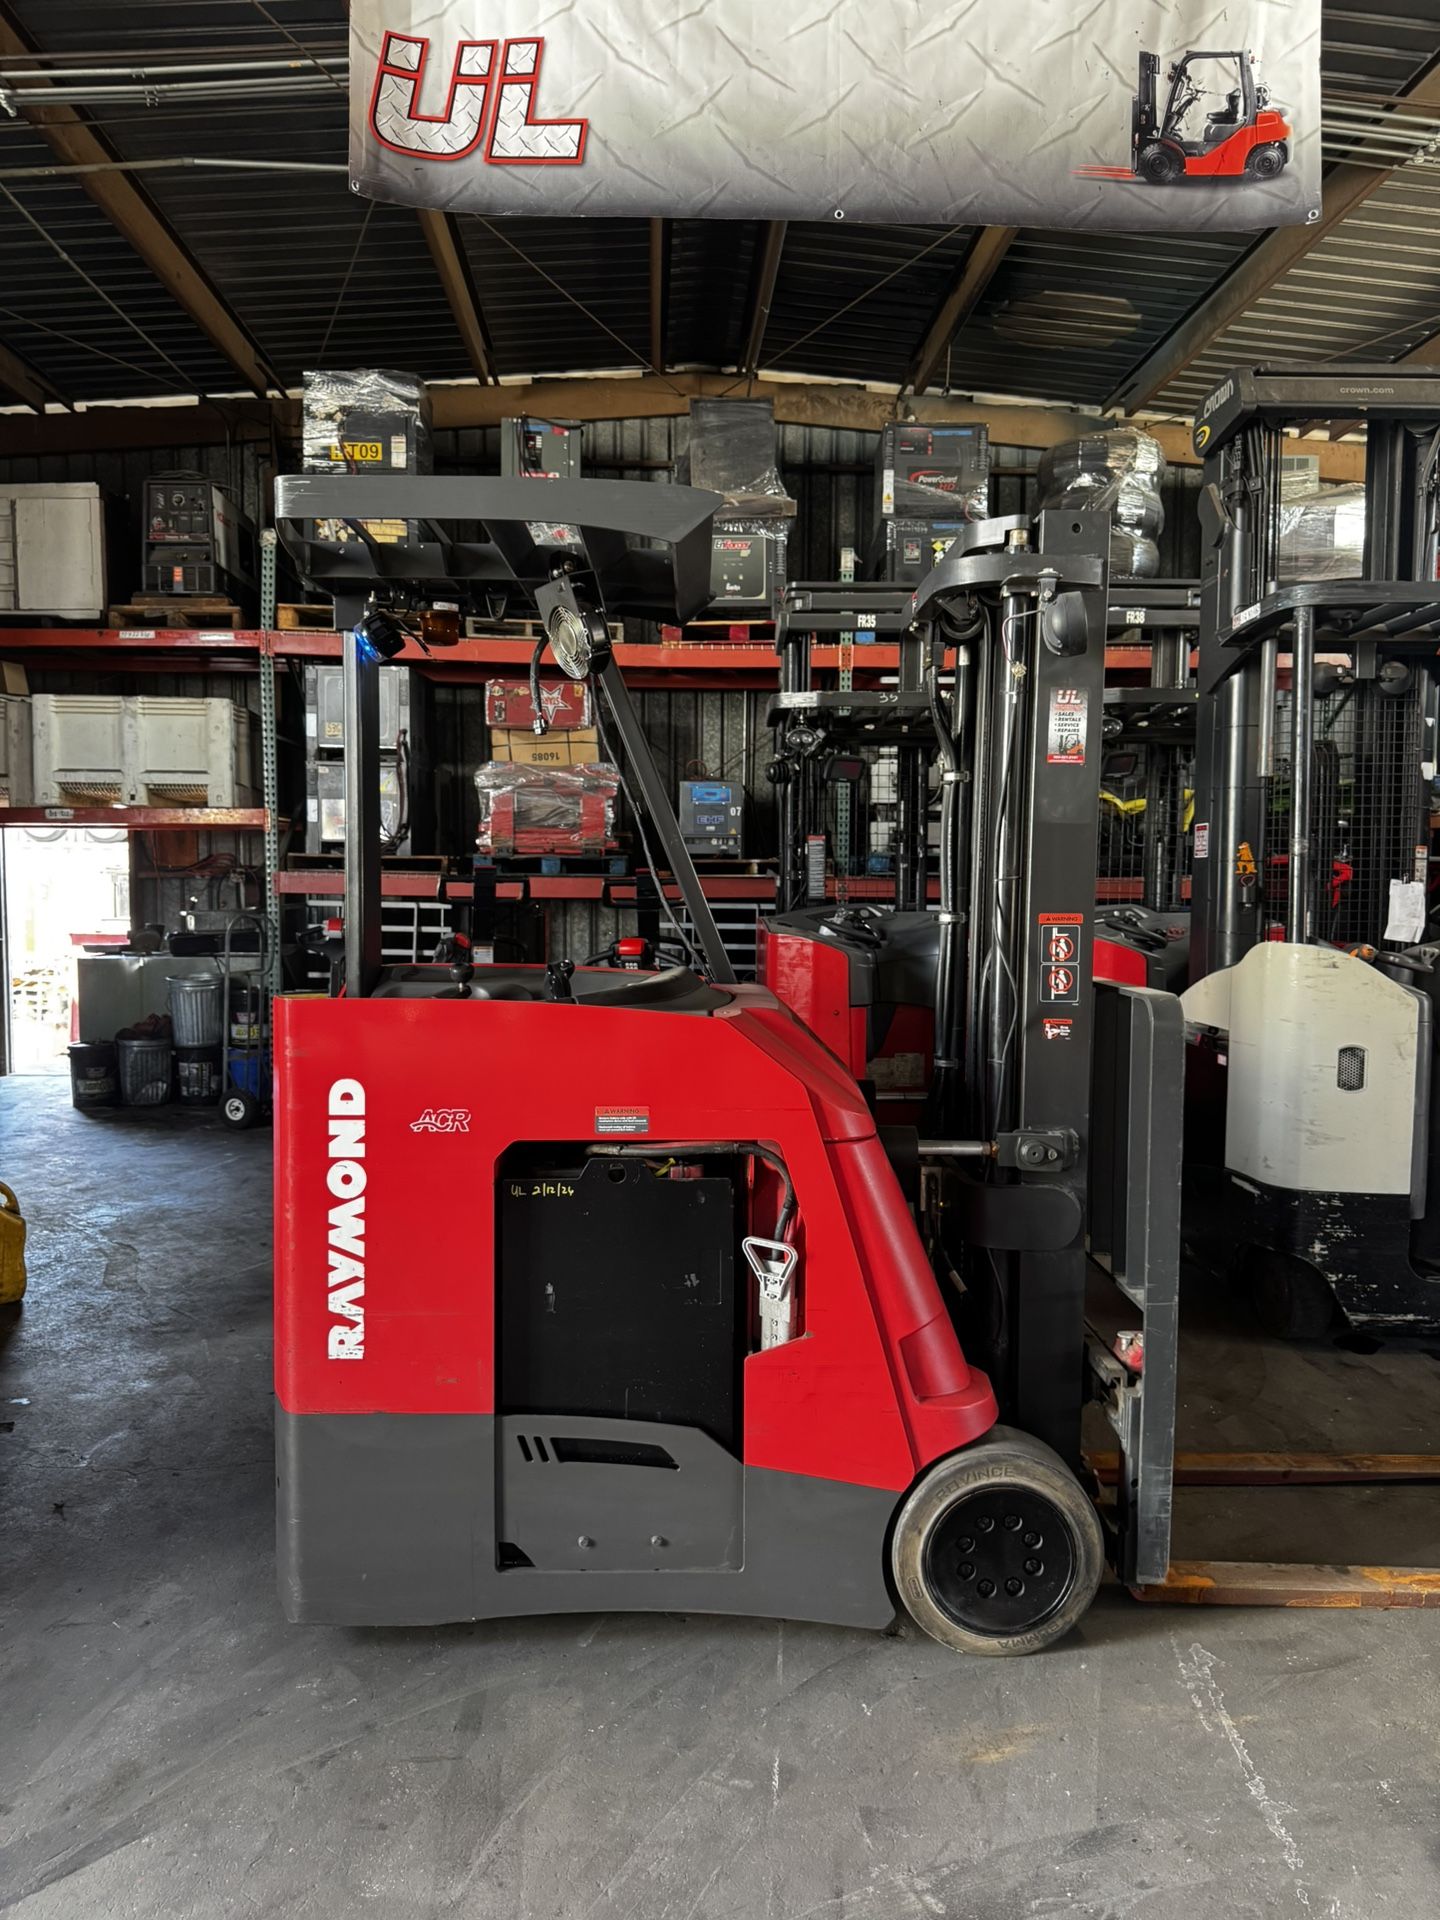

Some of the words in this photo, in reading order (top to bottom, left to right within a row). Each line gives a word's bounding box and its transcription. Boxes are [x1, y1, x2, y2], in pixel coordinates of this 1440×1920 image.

[368, 30, 588, 165] UL
[1339, 386, 1394, 394] crown.com
[918, 474, 958, 484] PowerGuard
[857, 614, 877, 628] FR35
[1125, 610, 1146, 624] FR38
[1056, 688, 1081, 704] UL
[531, 751, 560, 761] 16085
[730, 806, 742, 816] 07
[409, 1108, 472, 1132] ACR
[326, 1077, 367, 1360] RAYMOND
